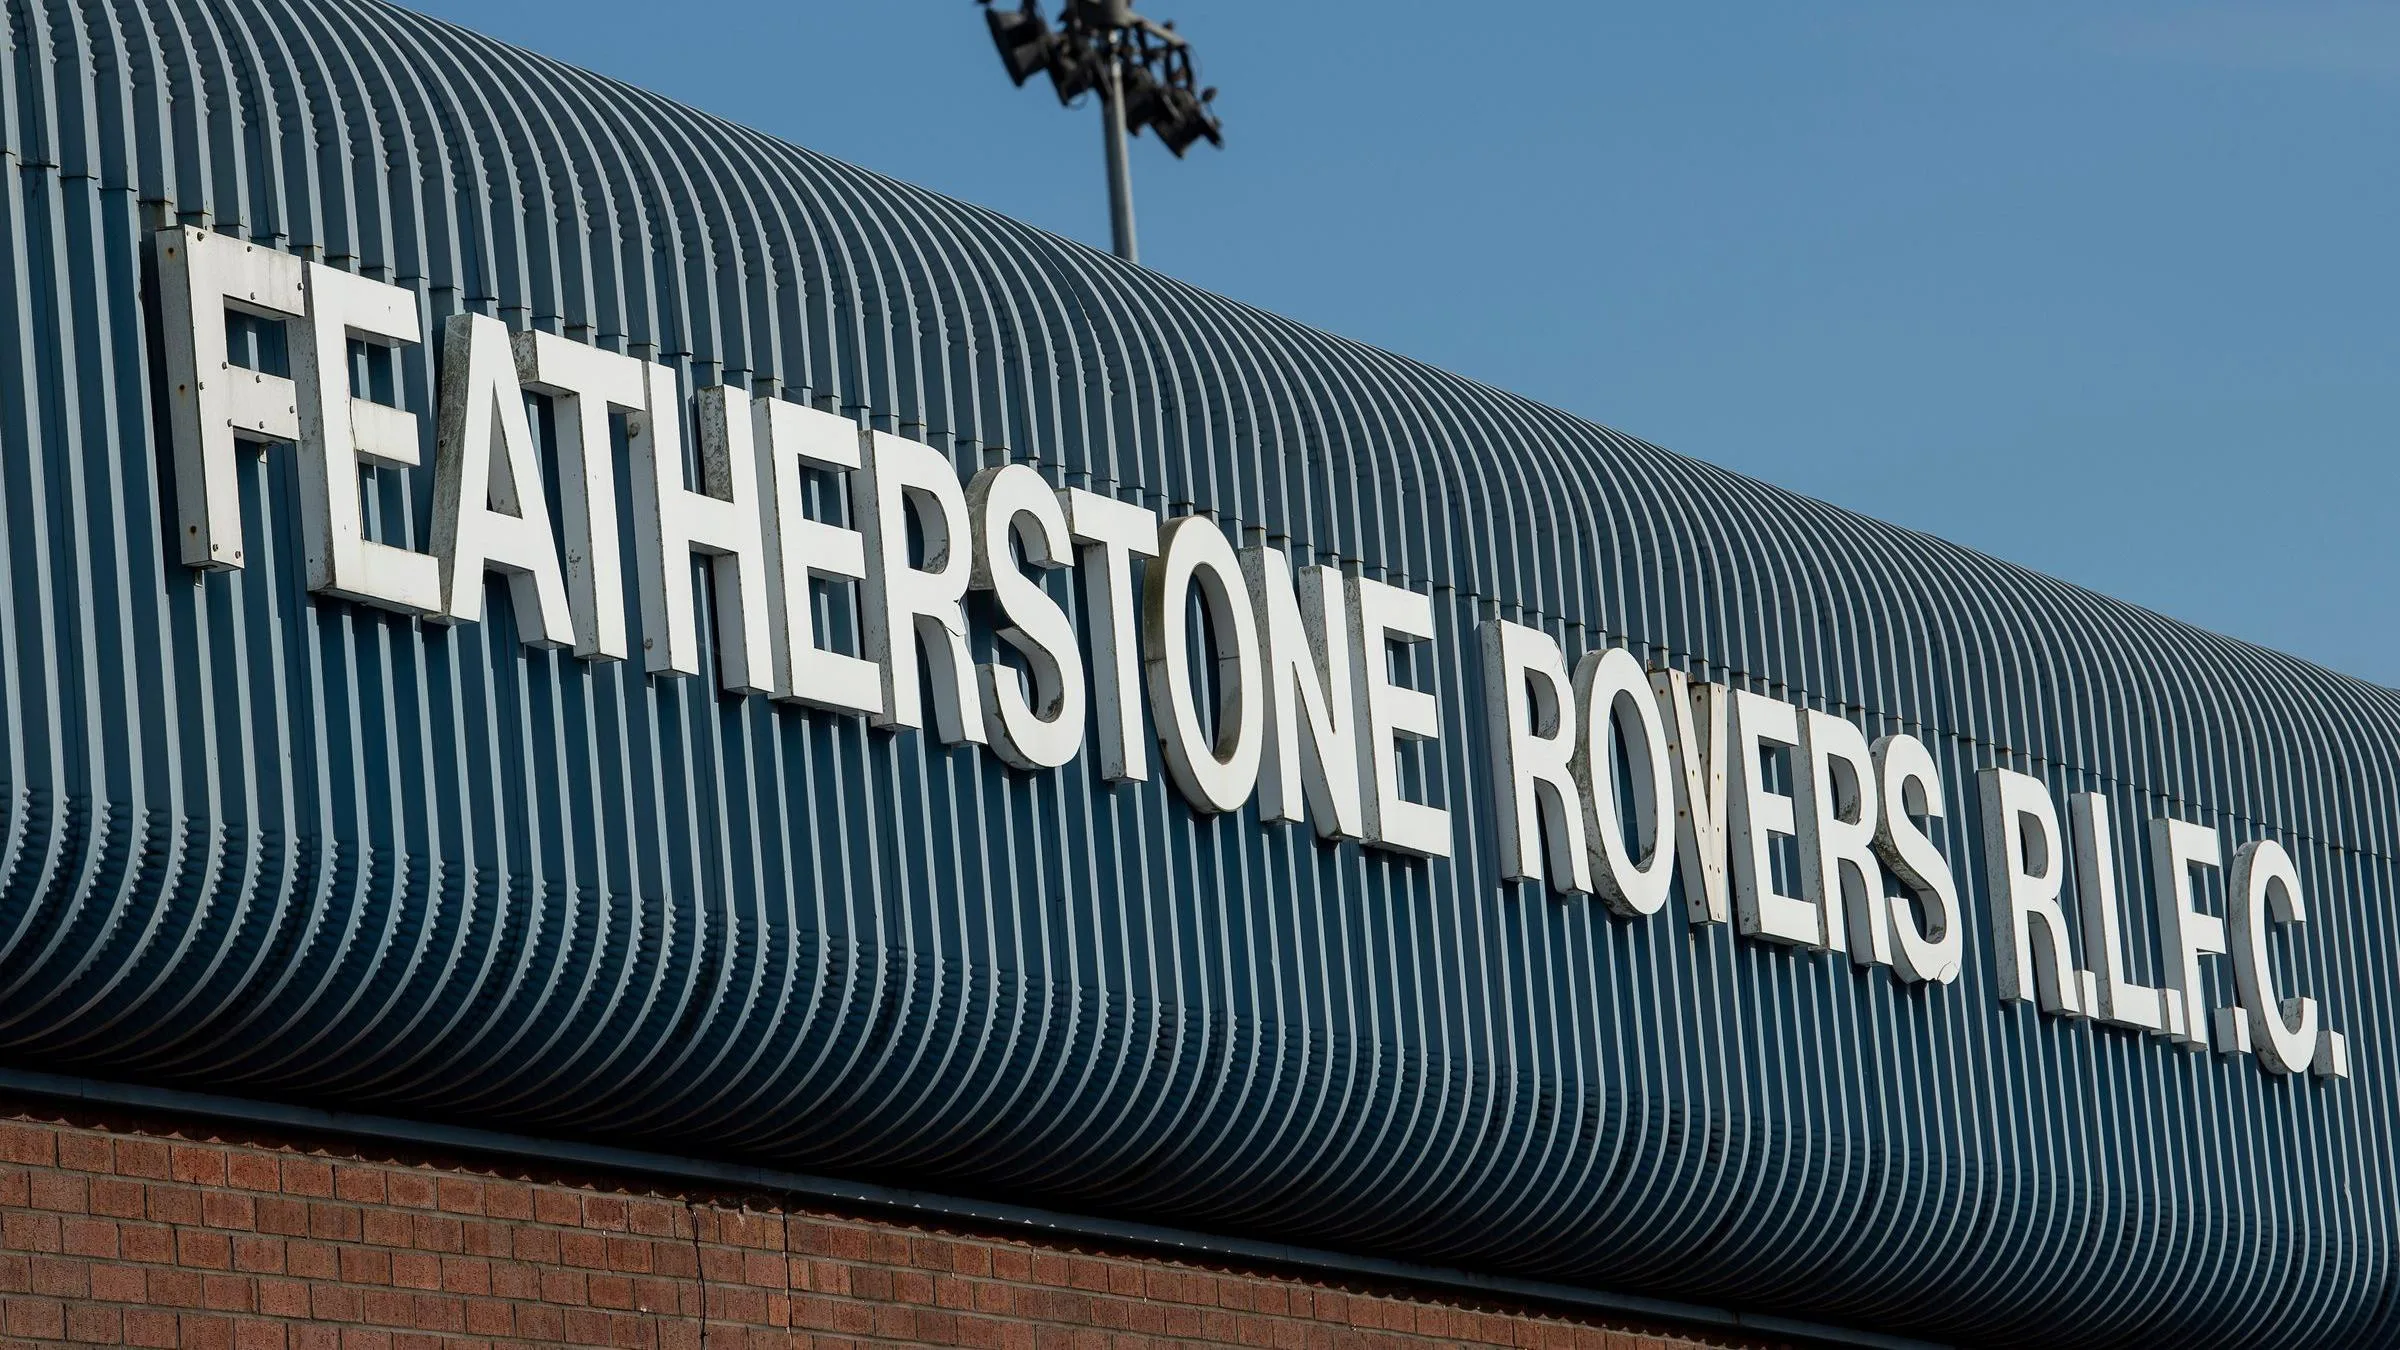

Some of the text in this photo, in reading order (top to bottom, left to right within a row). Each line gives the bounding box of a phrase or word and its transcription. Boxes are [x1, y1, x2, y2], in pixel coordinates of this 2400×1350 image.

[157, 225, 2348, 1079] FEATHERSTONE ROVERS R.L.F.C.
